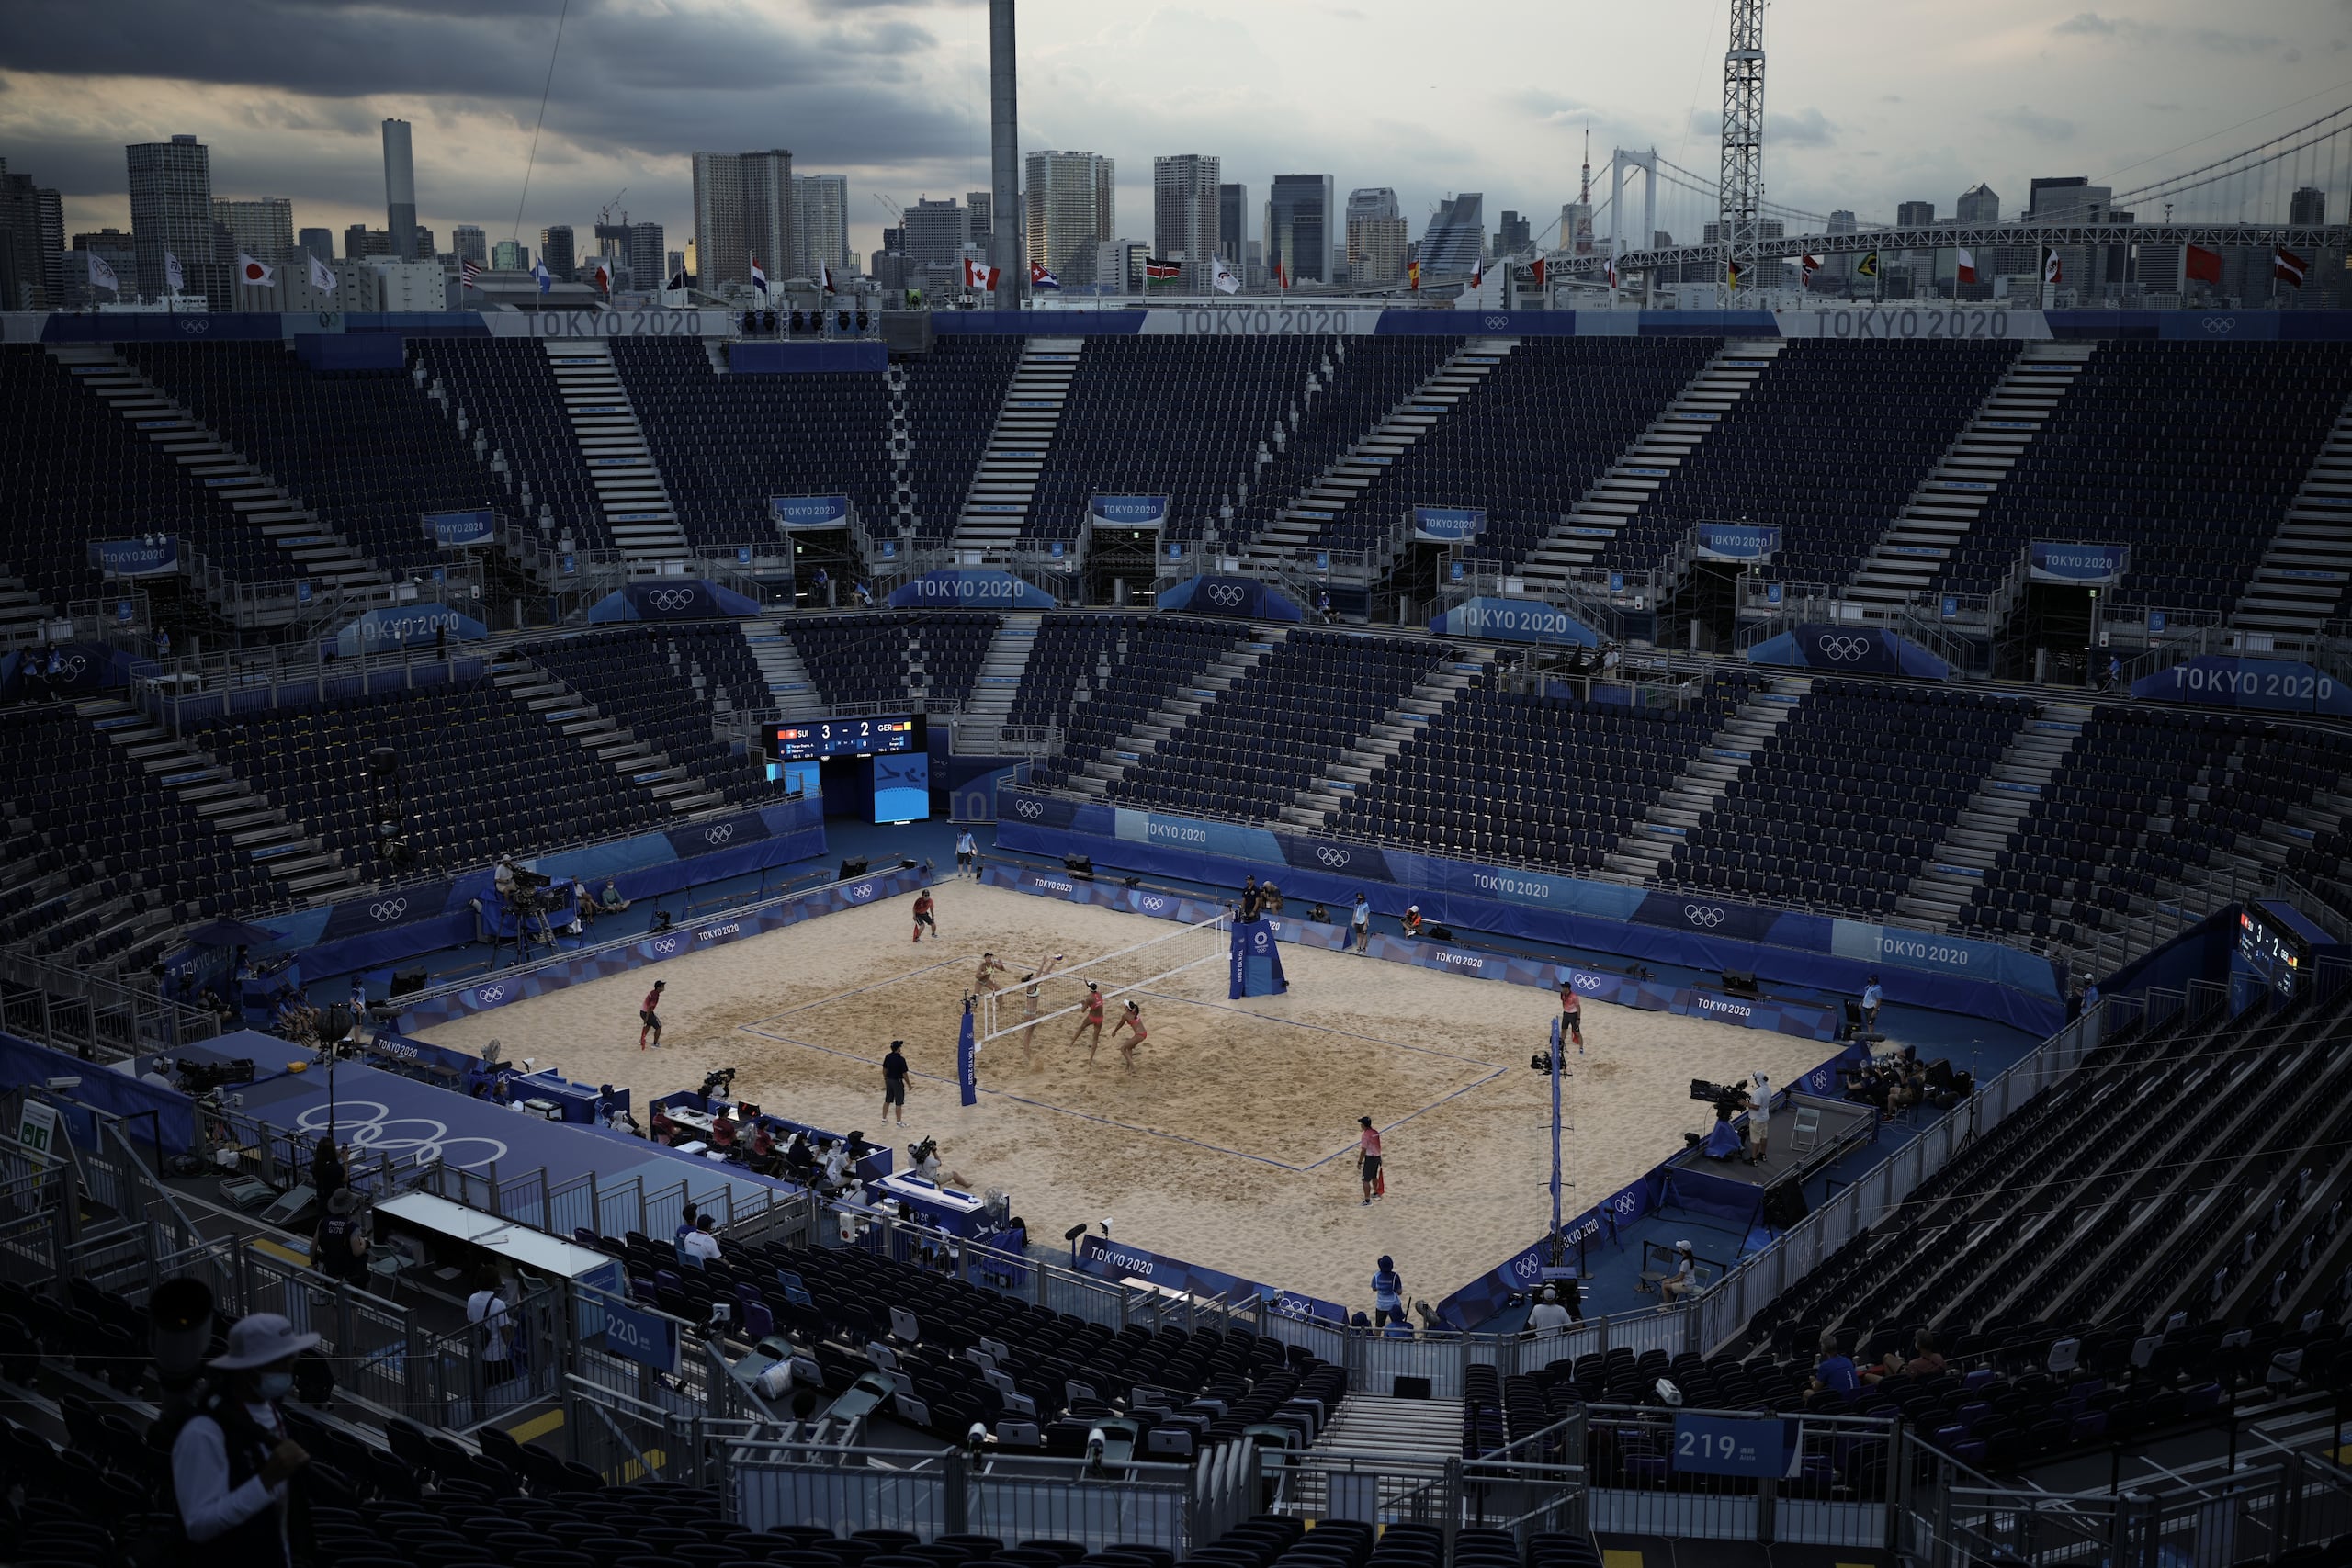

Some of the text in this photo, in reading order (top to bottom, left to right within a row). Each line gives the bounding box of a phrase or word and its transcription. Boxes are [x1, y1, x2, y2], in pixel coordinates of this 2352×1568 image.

[524, 310, 701, 337] TOKYO 2020
[1177, 310, 1347, 334] TOKYO 2020
[1815, 309, 2007, 338] TOKYO 2020
[783, 505, 836, 516] TOKYO 2020
[1103, 505, 1157, 514] TOKYO 2020
[437, 522, 484, 533] TOKYO 2020
[1425, 518, 1475, 530] TOKYO 2020
[1709, 535, 1767, 547] TOKYO 2020
[104, 549, 165, 563] TOKYO 2020
[2044, 554, 2112, 569] TOKYO 2020
[914, 580, 1024, 597] TOKYO 2020
[353, 613, 459, 643] TOKYO 2020
[1456, 606, 1566, 634] TOKYO 2020
[2173, 665, 2333, 701] TOKYO 2020
[797, 729, 809, 738] SUI
[822, 724, 831, 739] 3
[860, 721, 869, 736] 2
[877, 724, 892, 732] GER
[1144, 822, 1206, 842] TOKYO 2020
[1035, 878, 1073, 892] TOKYO 2020
[1473, 874, 1549, 897] TOKYO 2020
[697, 923, 739, 941] TOKYO 2020
[1435, 952, 1483, 968] TOKYO 2020
[1873, 937, 1968, 965] TOKYO 2020
[181, 952, 209, 976] TOKYO
[1698, 998, 1751, 1016] TOKYO 2020
[378, 1039, 418, 1058] TOKYO 2020
[1563, 1218, 1599, 1249] OKYO 2020
[1091, 1247, 1154, 1276] TOKYO 2020
[607, 1314, 638, 1346] 220
[1679, 1432, 1736, 1461] 219
